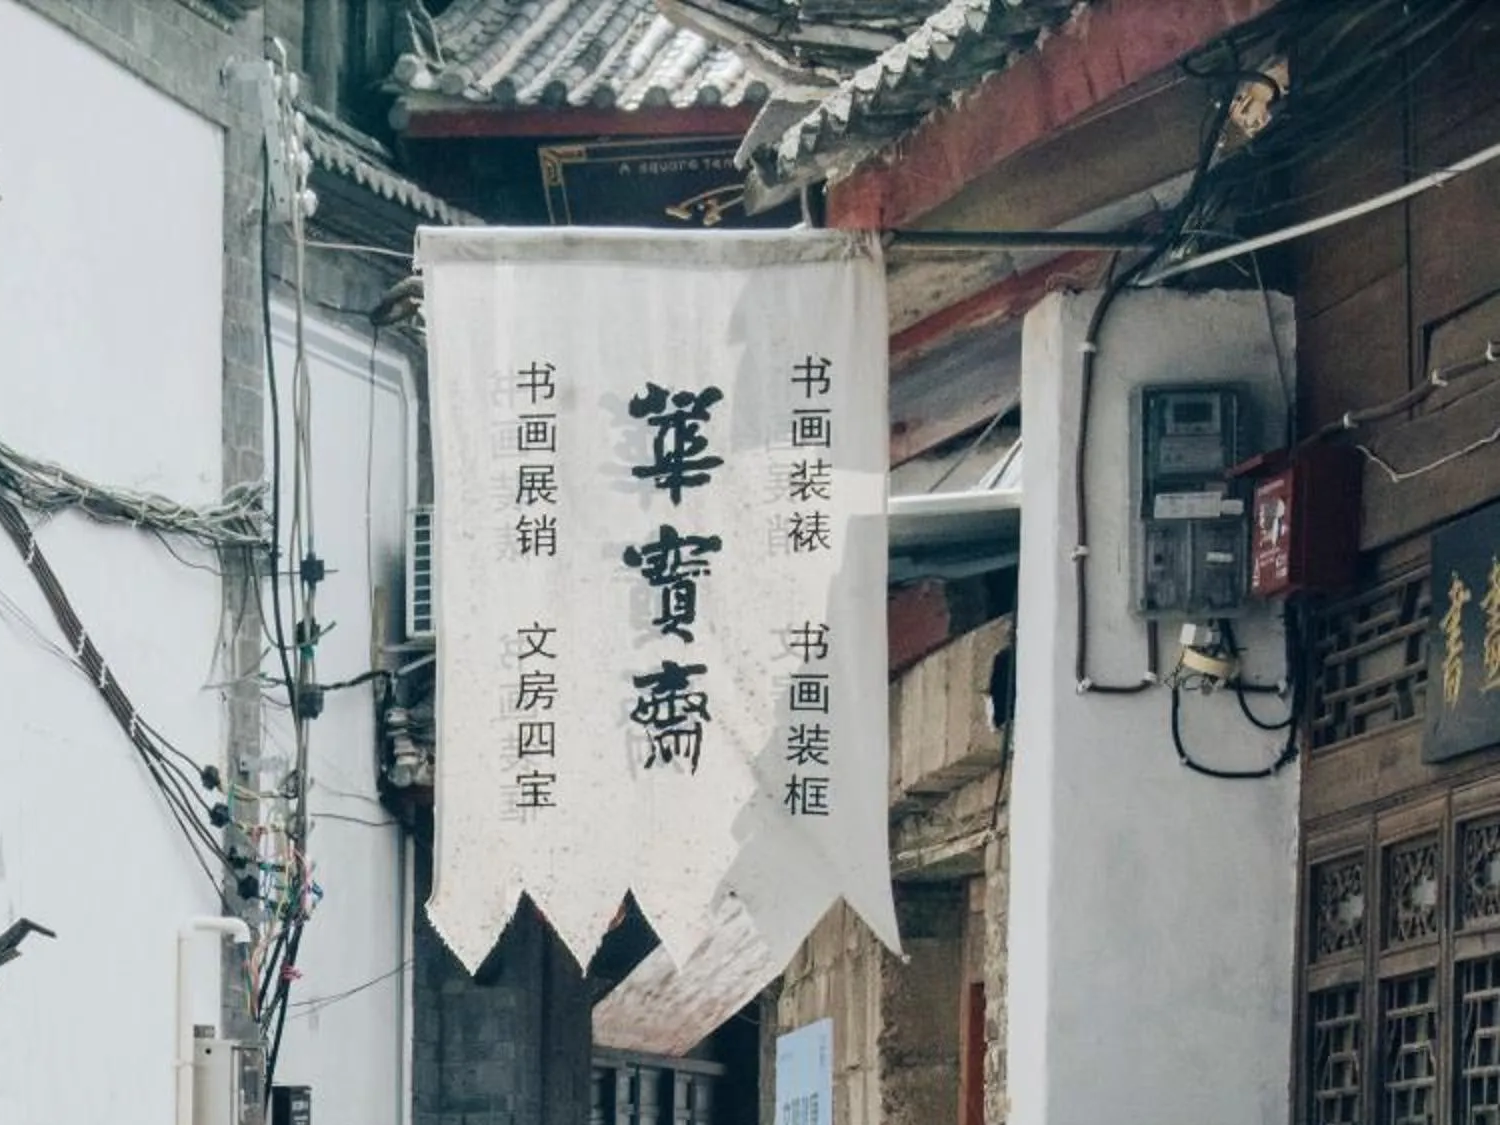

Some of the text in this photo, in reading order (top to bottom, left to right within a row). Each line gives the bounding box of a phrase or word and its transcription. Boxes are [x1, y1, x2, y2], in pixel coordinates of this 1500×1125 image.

[515, 361, 558, 808] 书画展销 文房四宝
[784, 355, 833, 817] 书画装裱 书画装框
